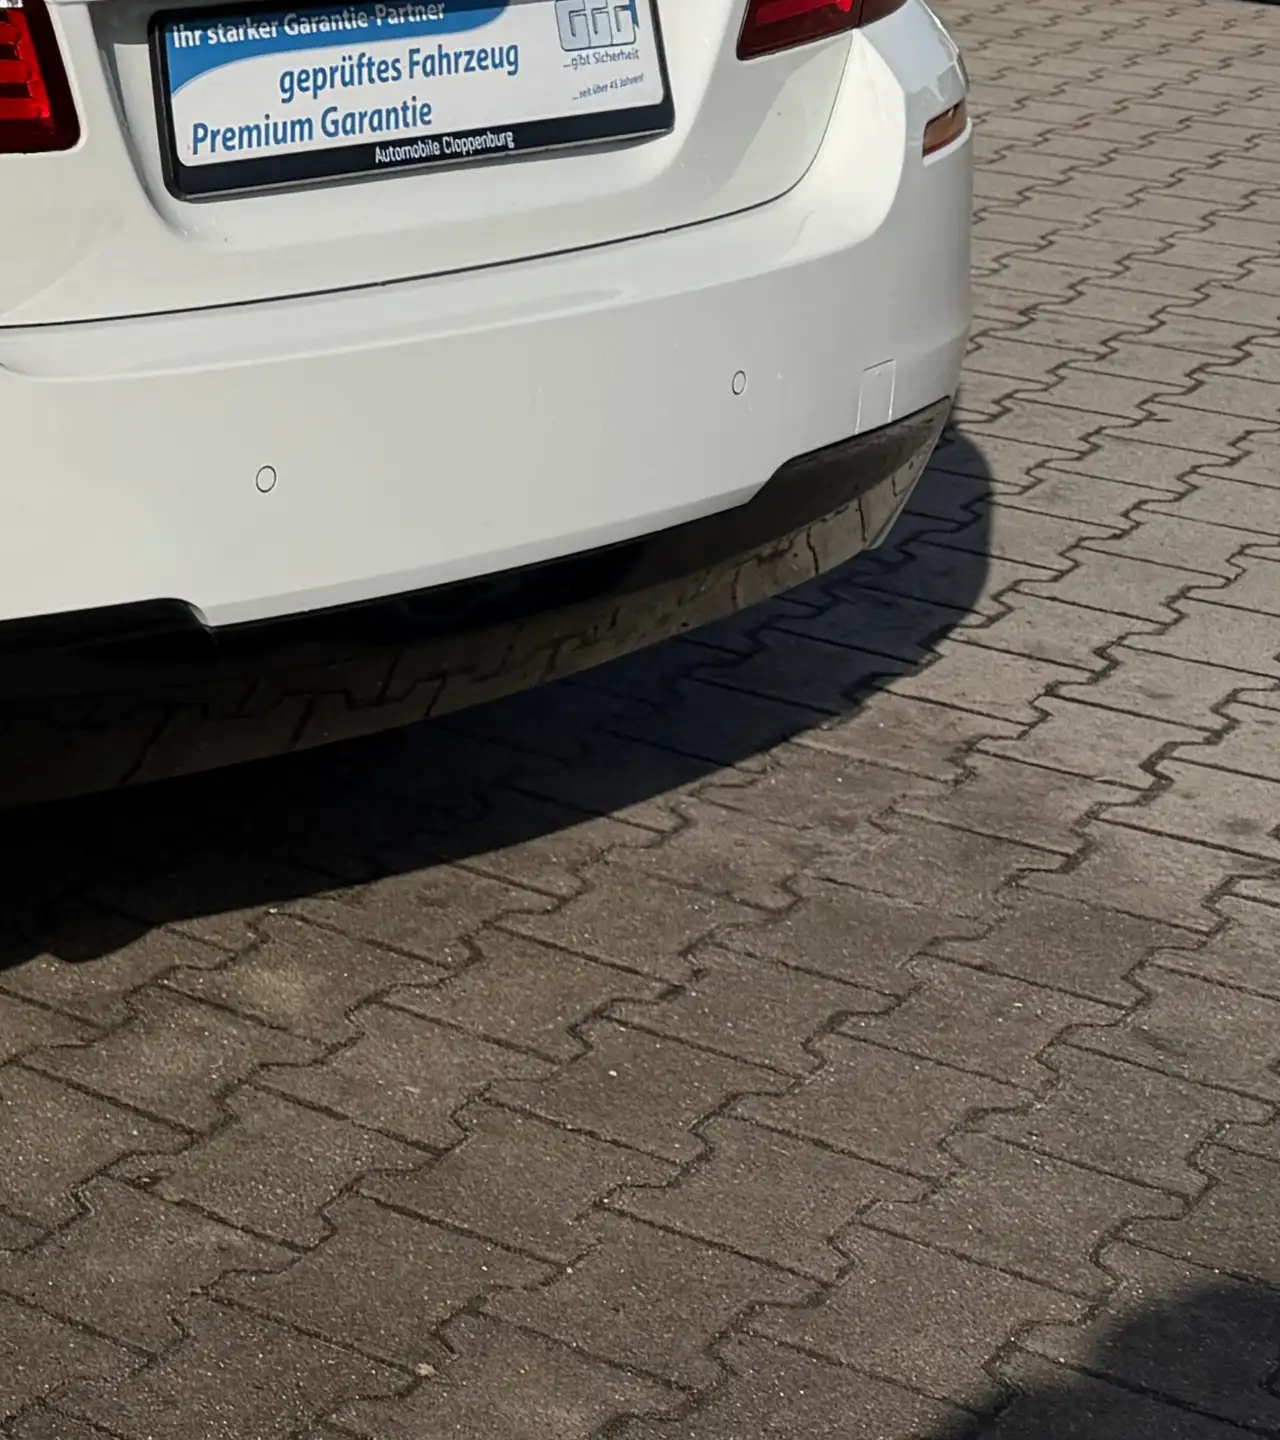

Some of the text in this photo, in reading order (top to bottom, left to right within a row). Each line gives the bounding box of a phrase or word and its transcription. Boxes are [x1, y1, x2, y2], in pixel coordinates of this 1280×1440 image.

[172, 0, 446, 49] Ihr starker Garantie-Partner
[279, 43, 520, 104] geprüftes Fahrzeug
[592, 47, 640, 64] Sicherheit
[192, 95, 433, 156] Premium Garantie
[374, 130, 516, 164] Automobile Cloppenburg
